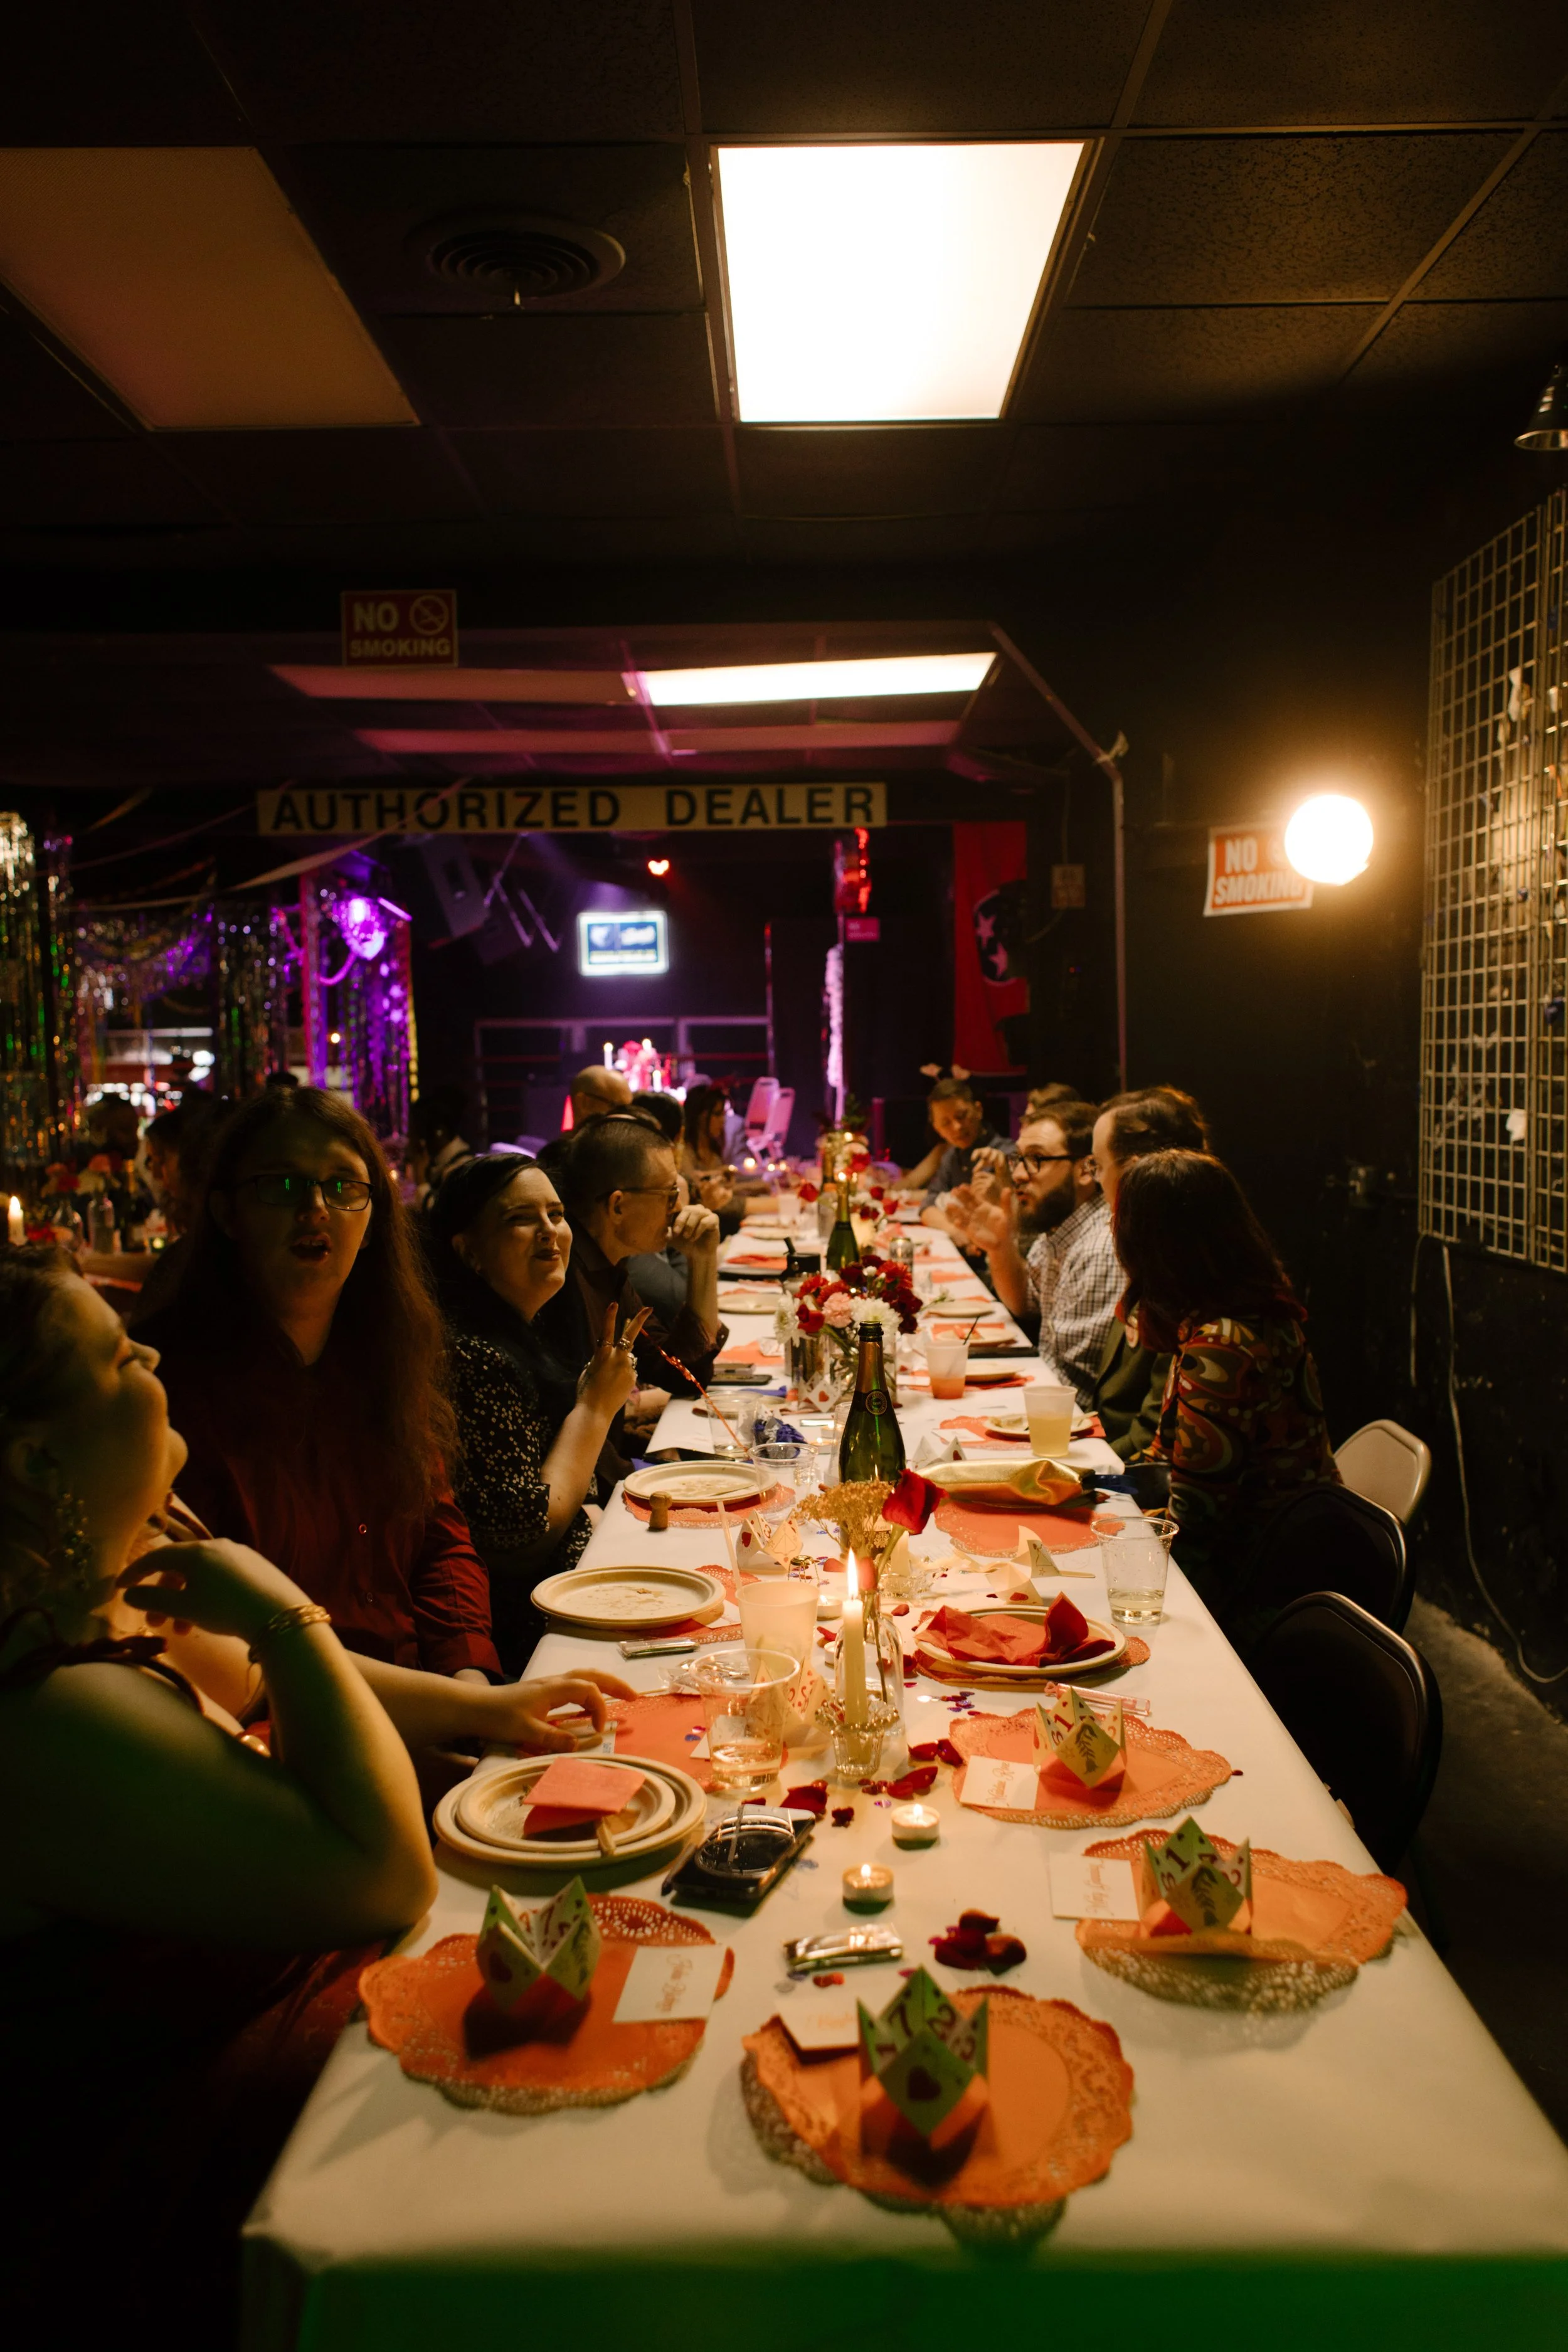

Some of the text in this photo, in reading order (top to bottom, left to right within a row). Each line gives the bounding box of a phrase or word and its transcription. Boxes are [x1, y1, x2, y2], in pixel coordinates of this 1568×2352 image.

[353, 600, 400, 633] NO
[349, 637, 451, 658] SMOKING
[271, 786, 874, 830] AUTHORIZED DEALER
[1225, 836, 1258, 874] NO
